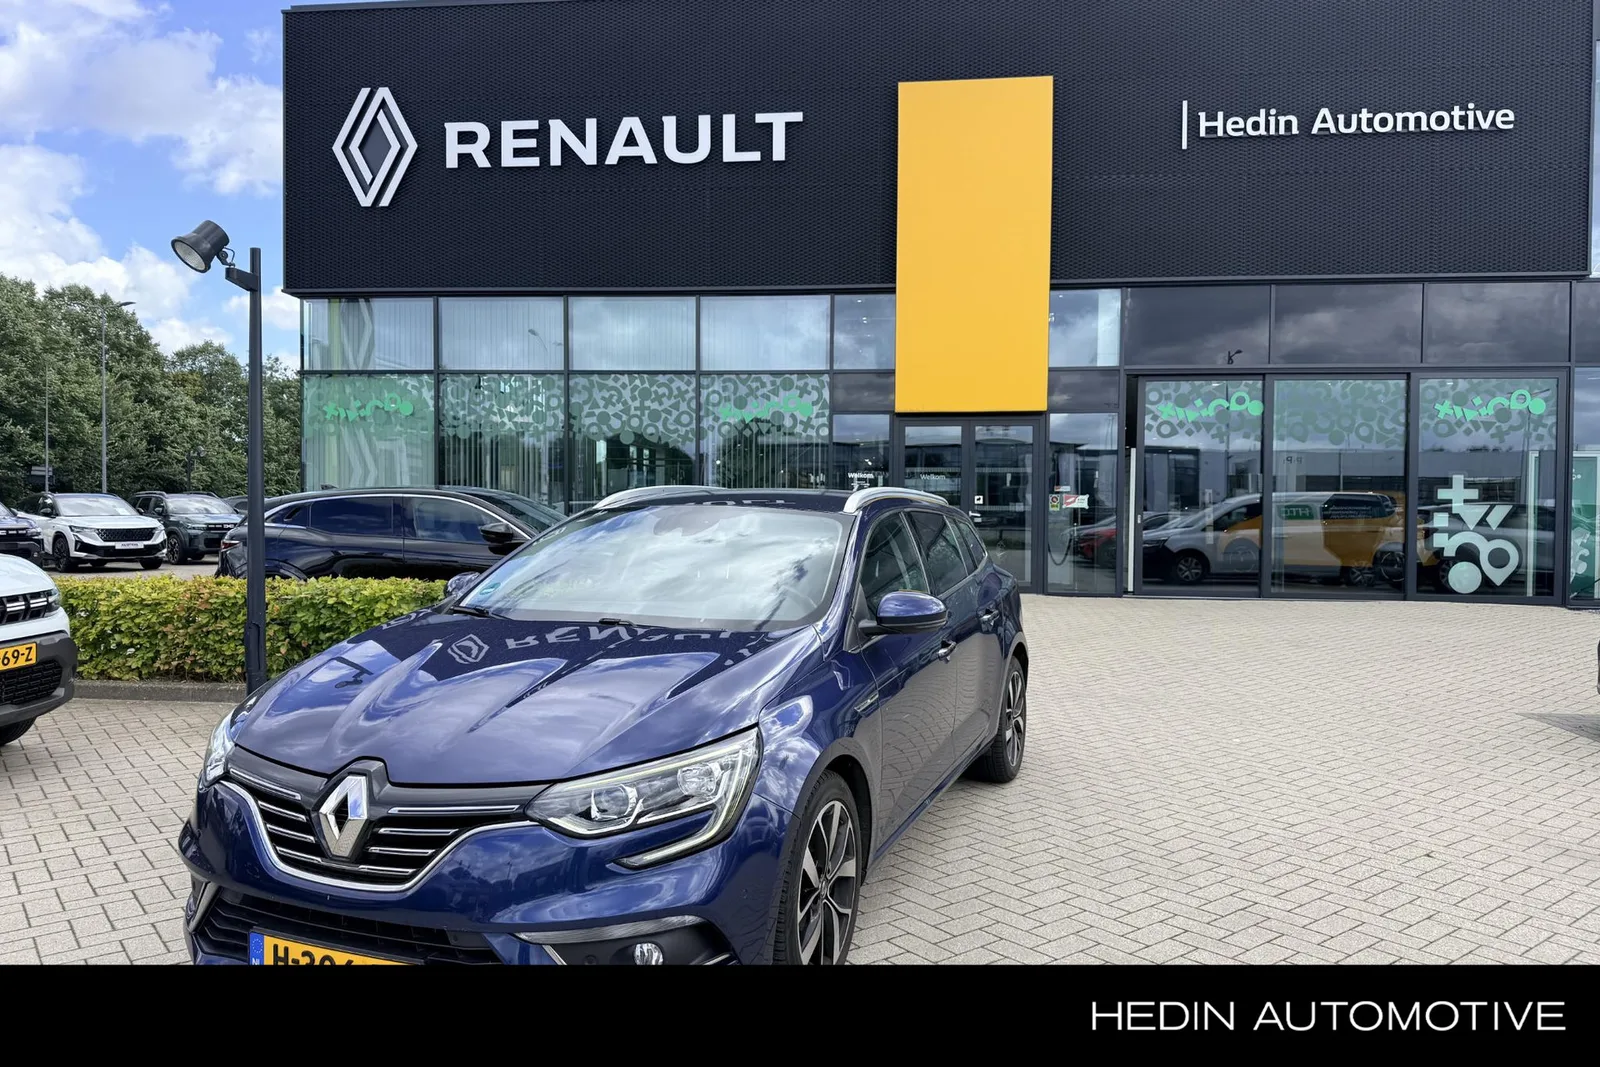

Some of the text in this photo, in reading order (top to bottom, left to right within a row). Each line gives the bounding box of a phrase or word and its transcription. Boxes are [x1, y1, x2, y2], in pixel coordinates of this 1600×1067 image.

[1198, 102, 1515, 137] Hedin Automotive
[444, 112, 803, 168] RENAULT
[0, 646, 33, 667] 69-Z
